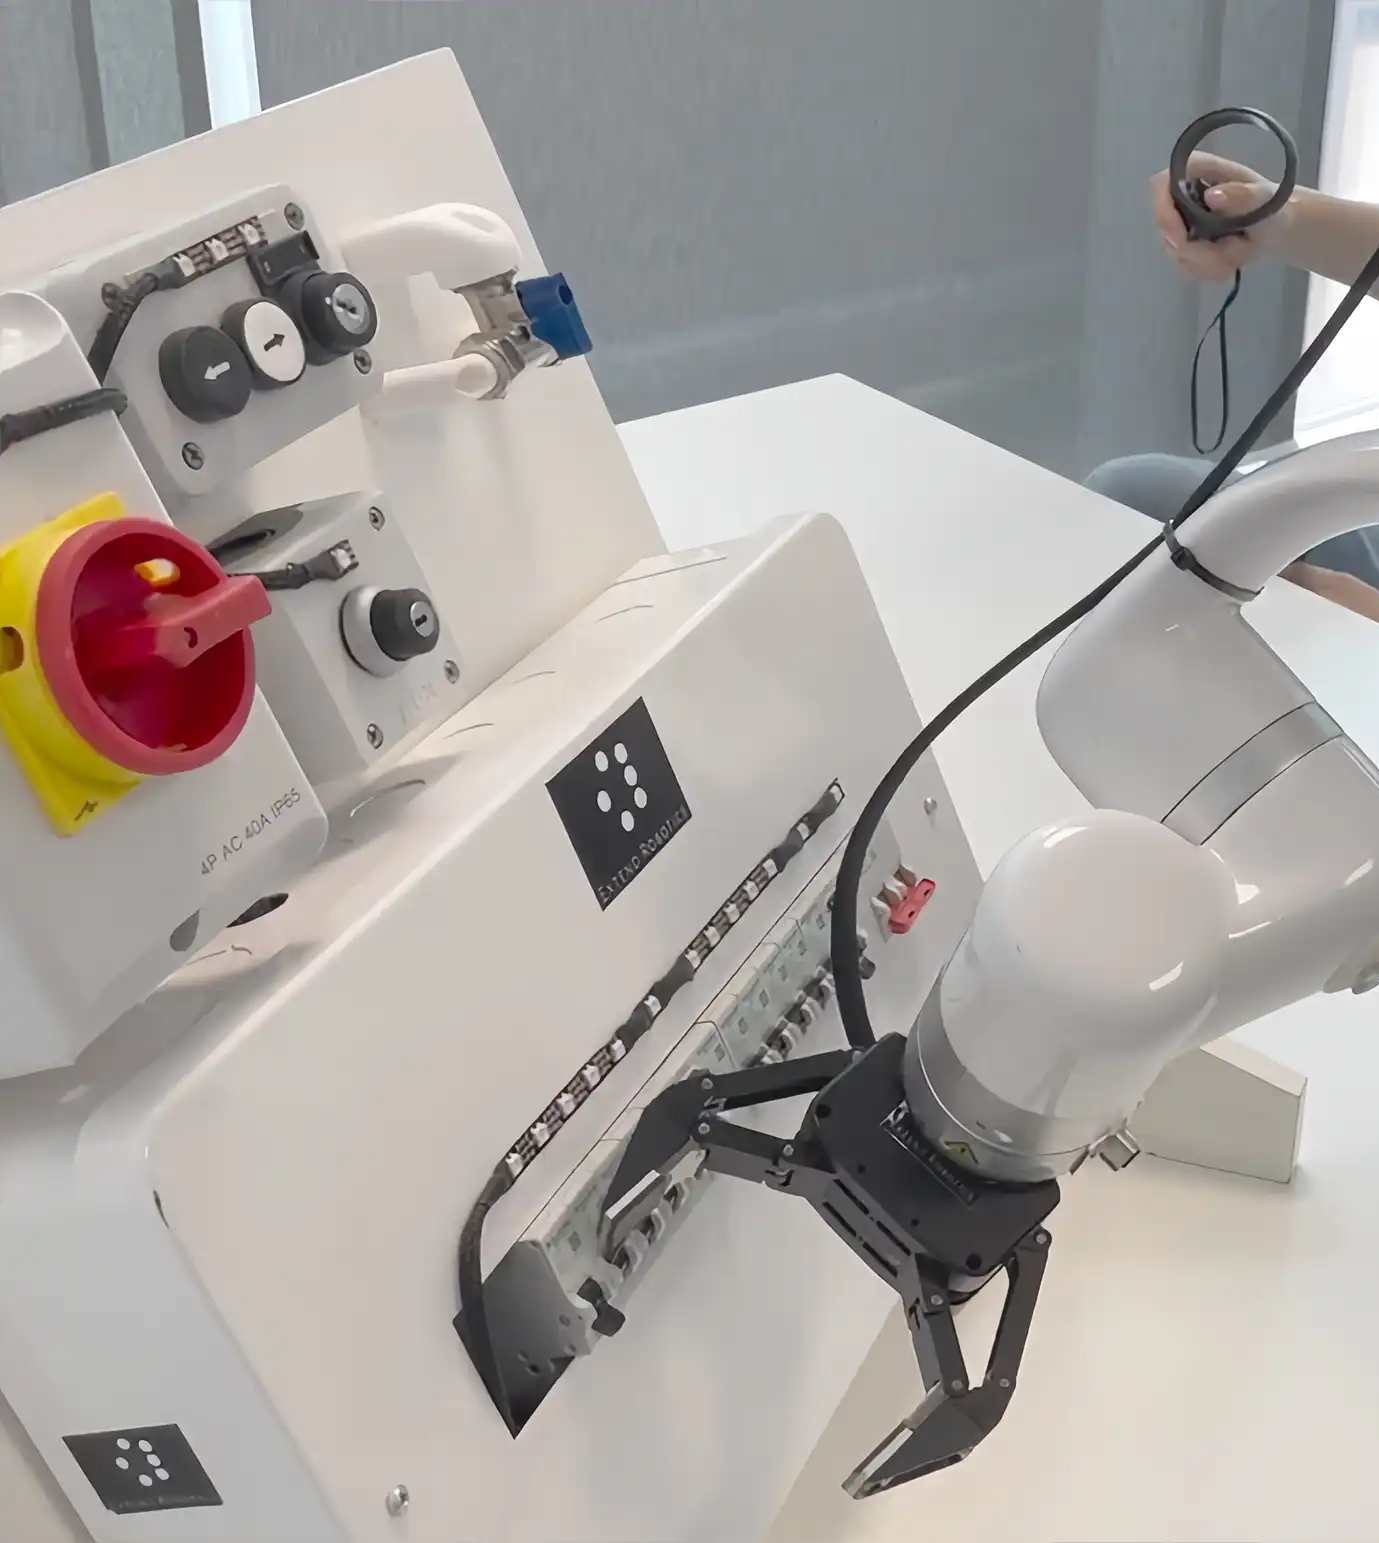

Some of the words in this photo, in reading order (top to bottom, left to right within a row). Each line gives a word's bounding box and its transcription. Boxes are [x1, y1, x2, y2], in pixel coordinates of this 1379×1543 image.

[201, 853, 217, 875] 4P
[222, 836, 243, 861] AC
[245, 813, 272, 840] 40A
[270, 787, 301, 819] IP65
